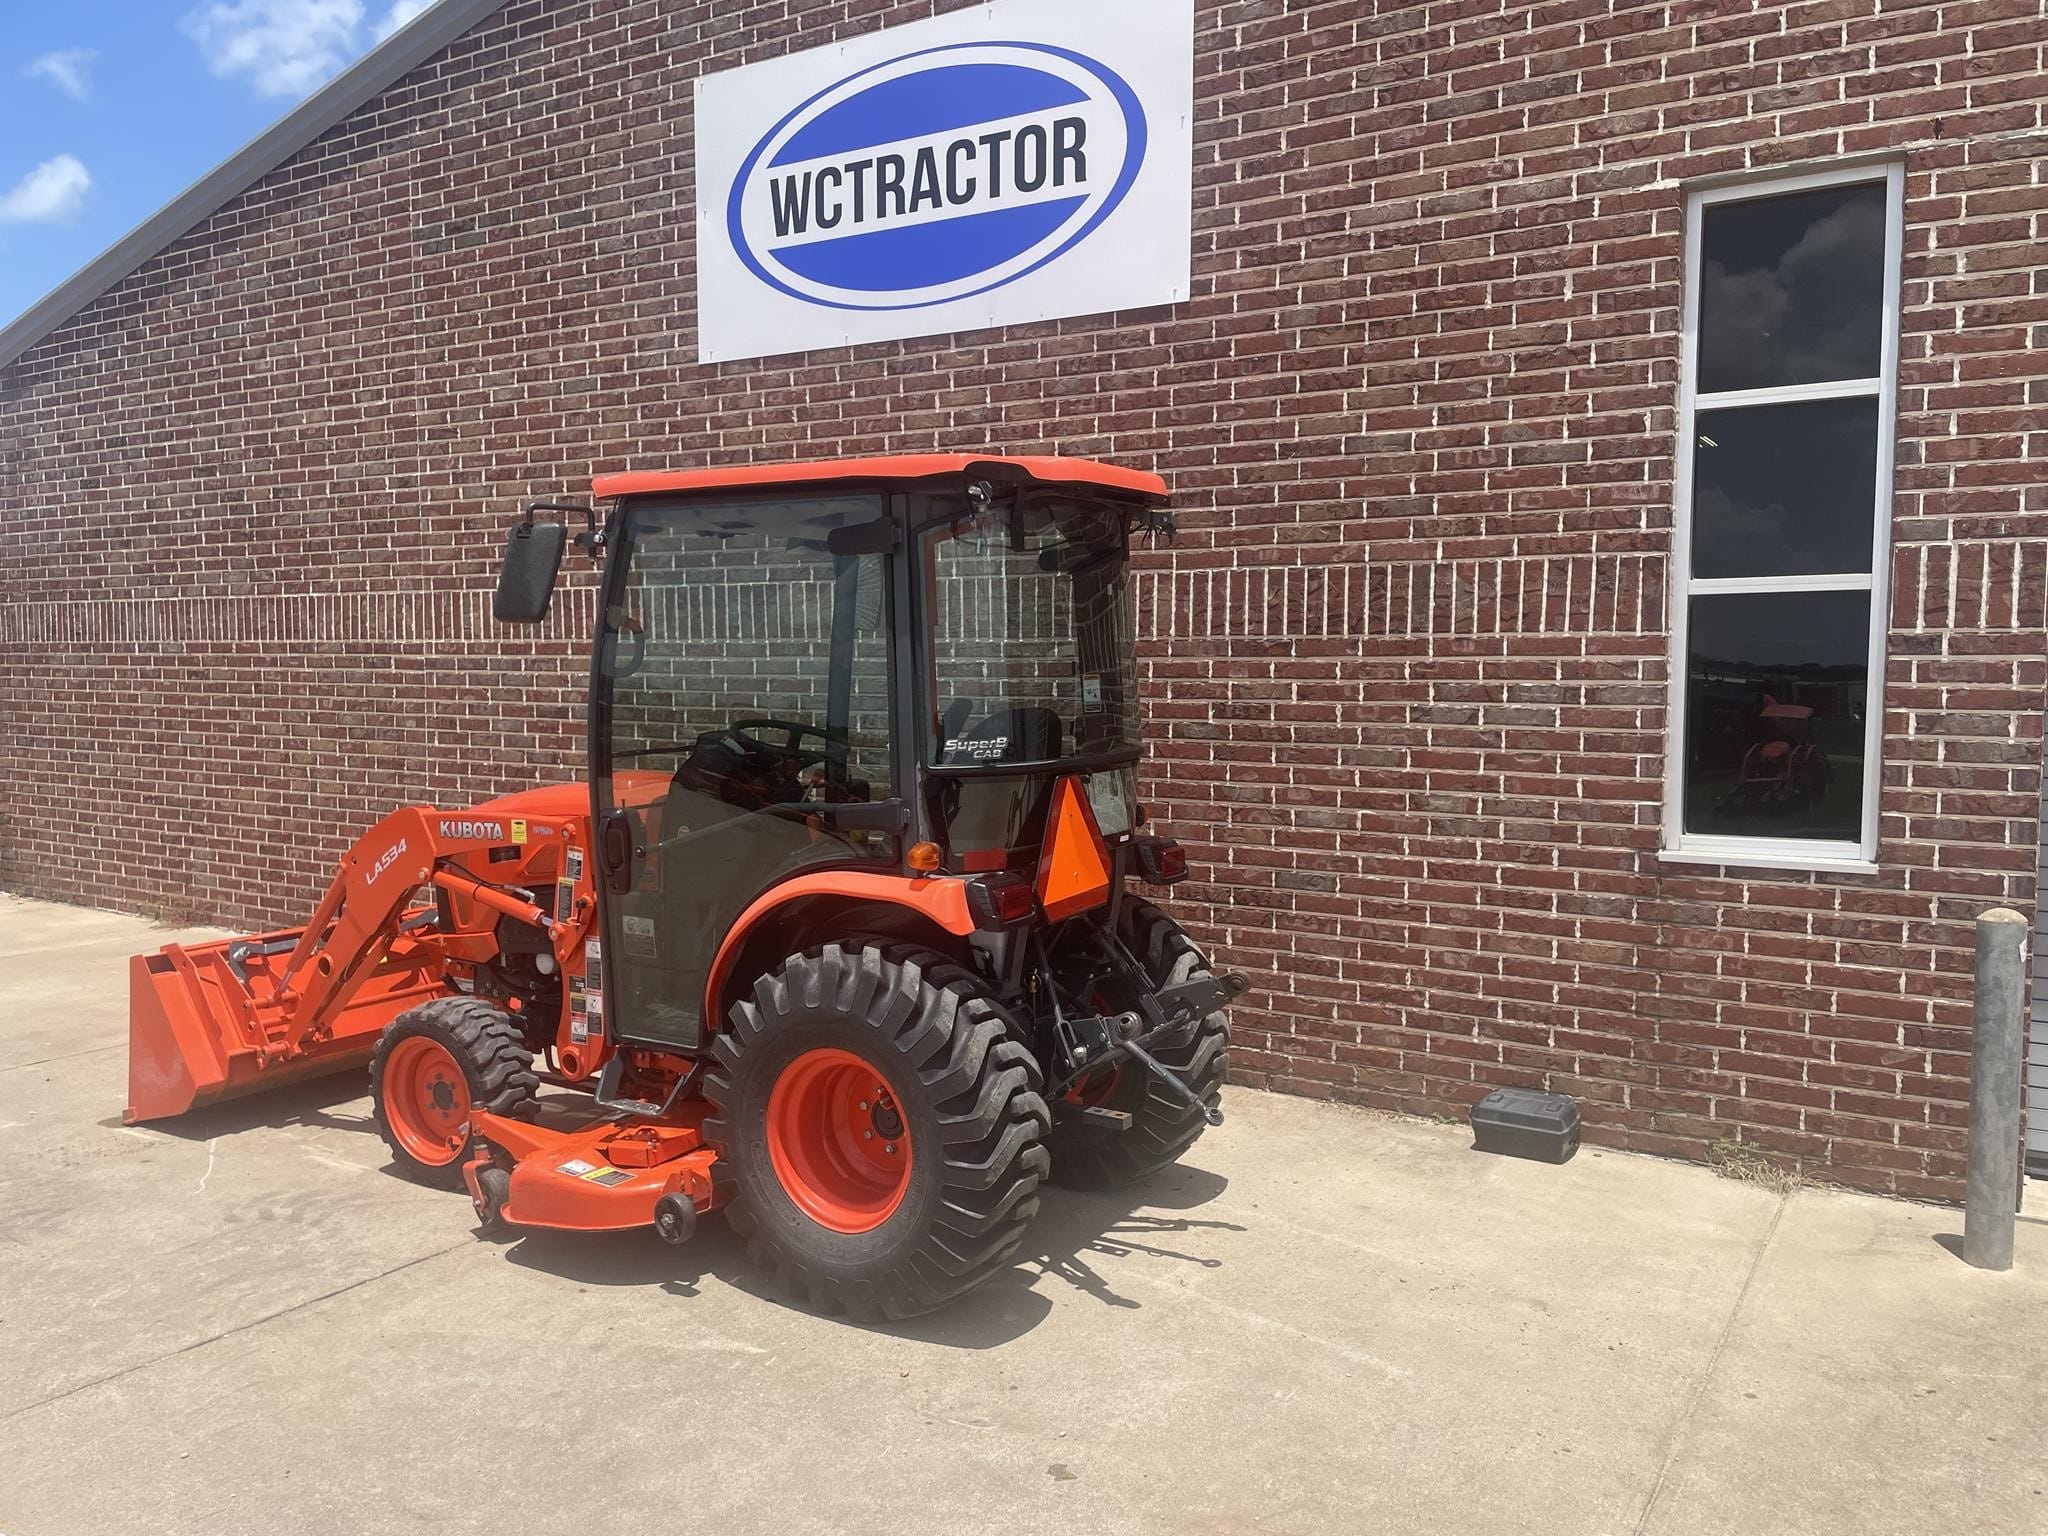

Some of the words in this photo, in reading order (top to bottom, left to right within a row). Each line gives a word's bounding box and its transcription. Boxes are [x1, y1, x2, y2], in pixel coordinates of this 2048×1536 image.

[770, 116, 1087, 237] WCTRACTOR
[440, 820, 503, 839] KUBOTA
[365, 838, 407, 885] LA534
